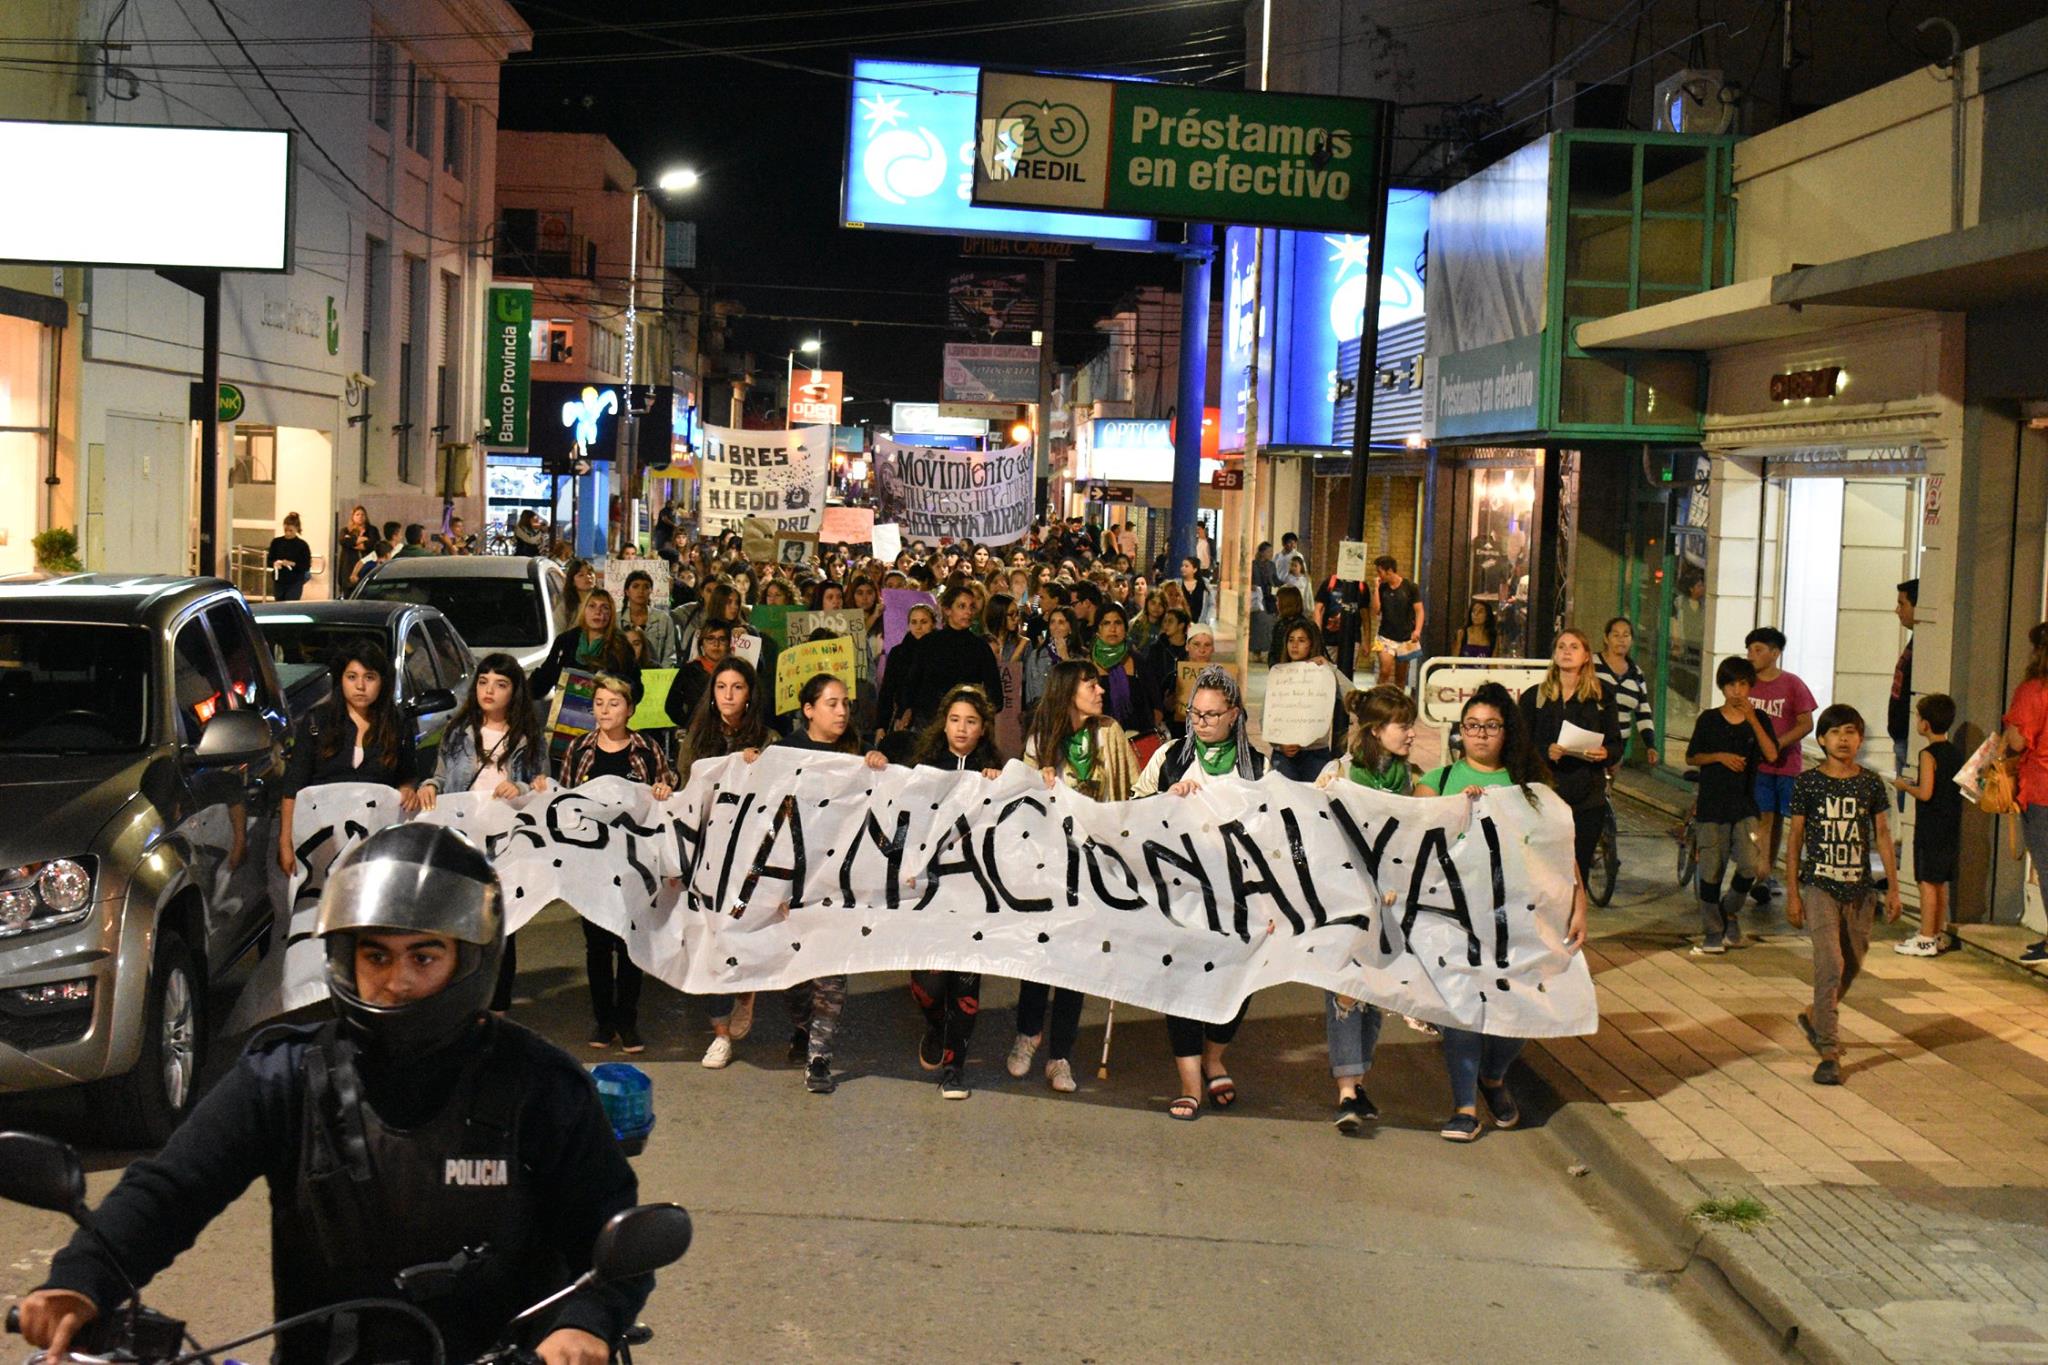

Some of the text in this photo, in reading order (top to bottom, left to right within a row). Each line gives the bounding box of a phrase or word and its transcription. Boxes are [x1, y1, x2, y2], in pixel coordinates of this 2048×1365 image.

[1131, 105, 1352, 160] Préstamos
[1128, 156, 1351, 201] en efectivo
[498, 325, 518, 442] Banco Provincia
[707, 440, 789, 467] LIBRES
[730, 468, 758, 486] DE
[897, 450, 1014, 490] Movimiento
[708, 489, 779, 511] MIEDO
[849, 618, 865, 632] ES
[1825, 797, 1857, 819] MO
[1821, 820, 1861, 842] TIVA
[1818, 844, 1862, 865] TION
[838, 795, 1370, 943] NACIONAL
[445, 1158, 508, 1186] POLICIA
